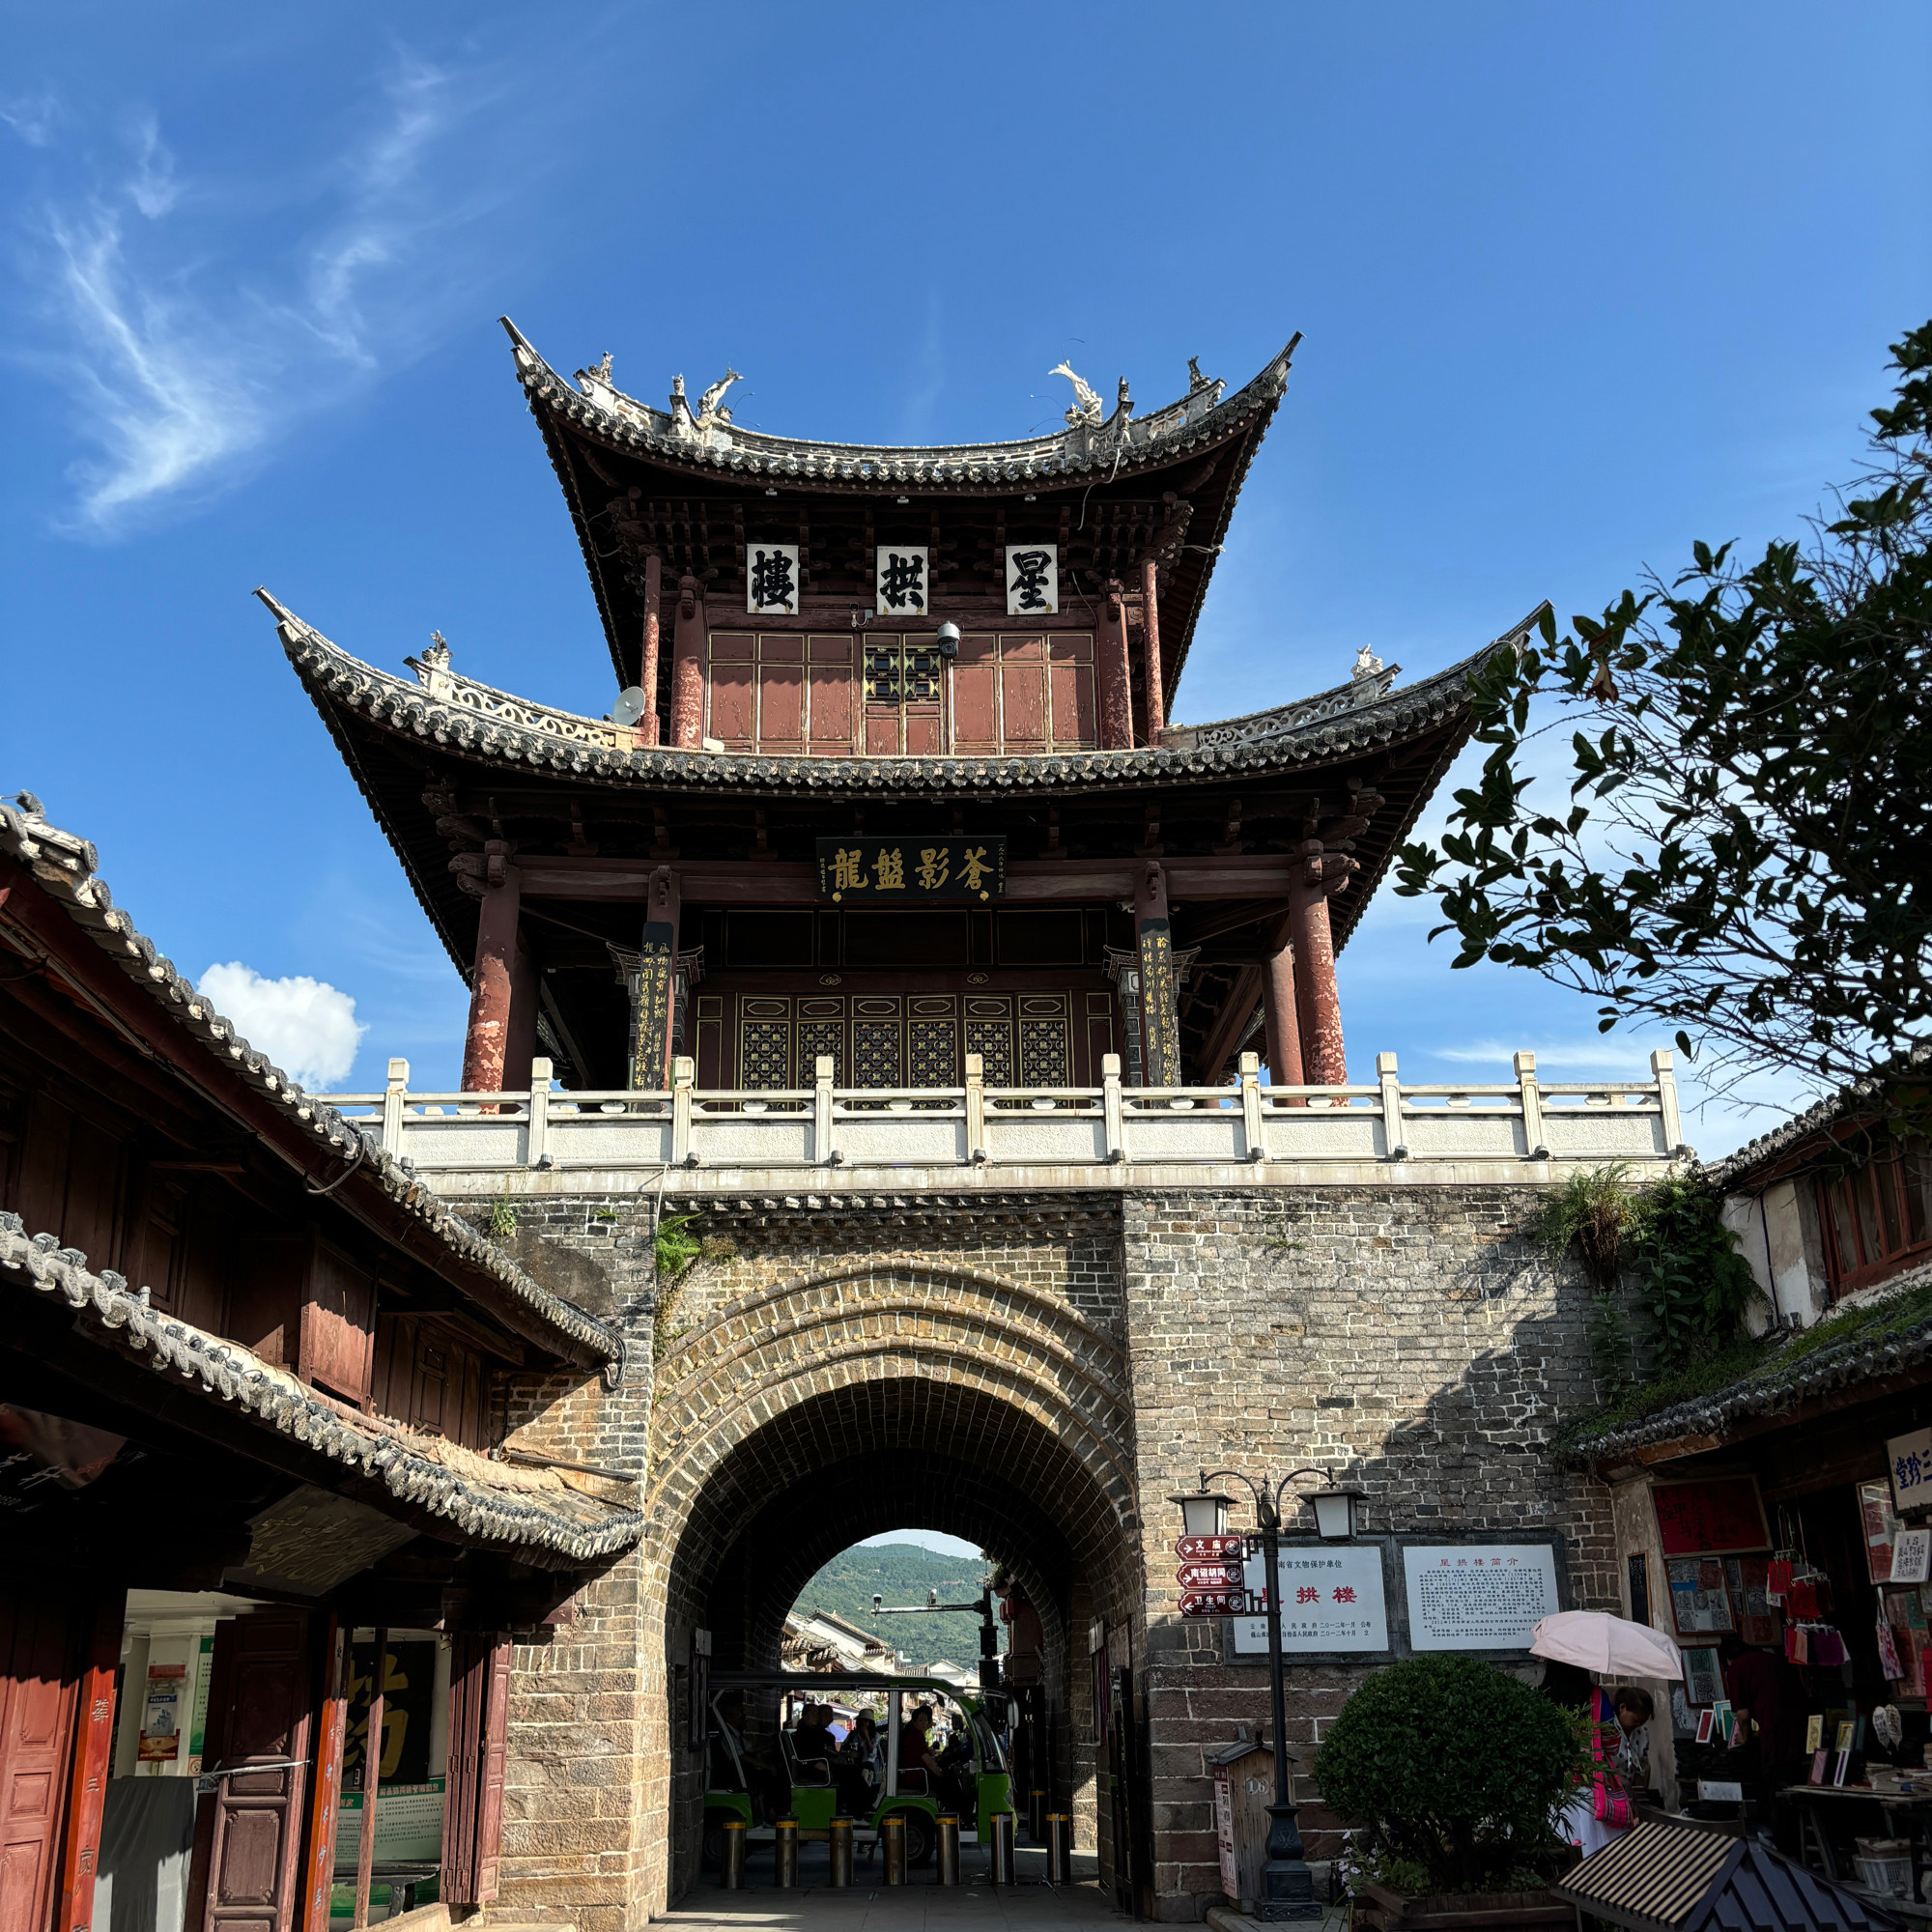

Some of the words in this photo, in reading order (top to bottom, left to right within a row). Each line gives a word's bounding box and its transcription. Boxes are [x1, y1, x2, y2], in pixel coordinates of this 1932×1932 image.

[1196, 1540, 1221, 1549] 文庙
[1278, 1559, 1343, 1569] 南省文物保护单位
[1439, 1557, 1519, 1567] 星拱楼简介
[1194, 1595, 1226, 1605] 卫生间
